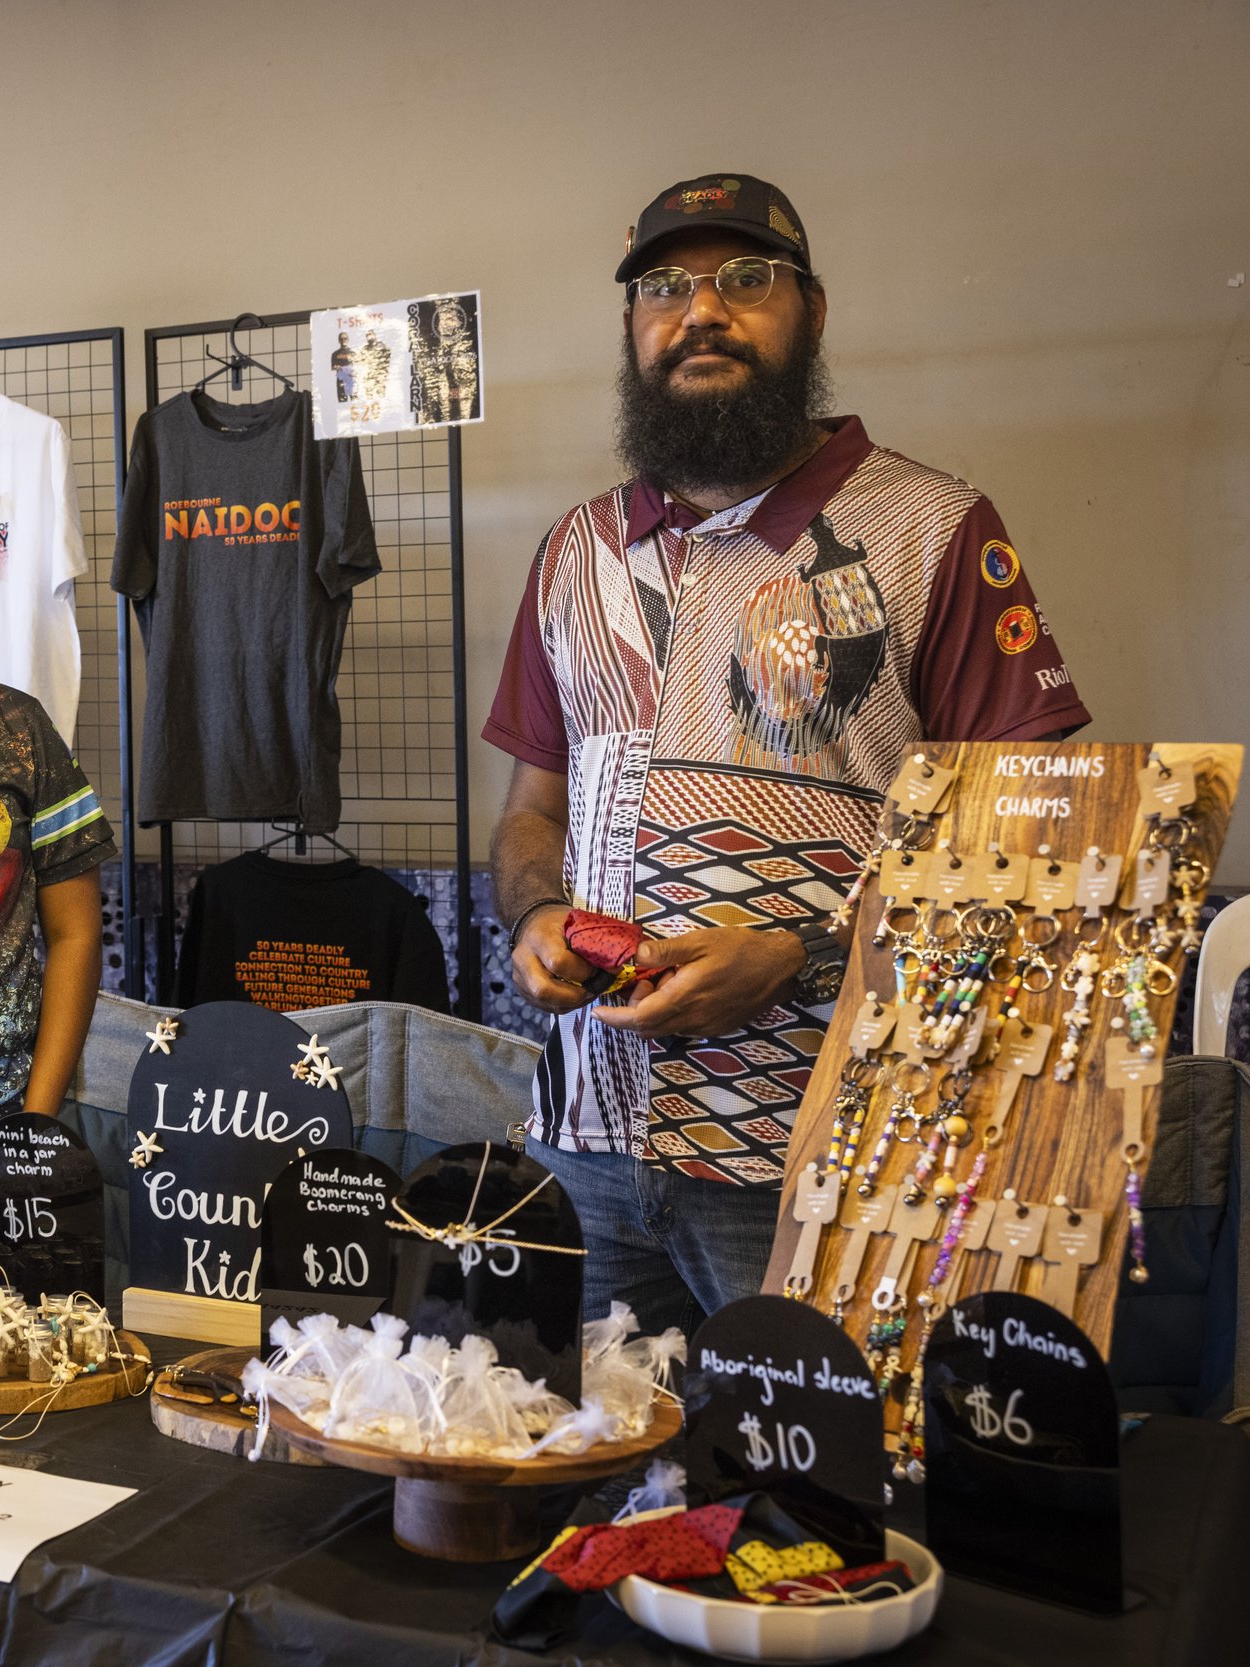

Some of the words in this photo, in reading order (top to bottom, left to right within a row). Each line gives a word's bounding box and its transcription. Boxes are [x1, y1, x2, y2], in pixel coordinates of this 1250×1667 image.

[164, 498, 221, 511] ROEBOURNE
[165, 500, 300, 540] NAIDOC
[237, 534, 268, 545] YEARS
[994, 755, 1105, 778] KEYCHAINS
[995, 796, 1071, 818] CHARMS
[249, 952, 305, 963] CELEBRATE
[307, 956, 350, 967] CULTURE
[256, 941, 270, 950] 50
[272, 942, 302, 952] YEARS
[306, 944, 344, 955] DEADLY
[278, 973, 326, 985] THROUGH
[304, 965, 317, 974] TO
[320, 967, 368, 979] COUNTRY
[245, 982, 284, 993] FUTURE
[286, 984, 356, 999] GENERATIONS
[154, 1082, 329, 1145] Little
[28, 1127, 70, 1147] beach
[3, 1142, 17, 1158] in
[19, 1149, 29, 1159] a
[33, 1149, 56, 1164] jar
[6, 1161, 53, 1176] charm
[303, 1161, 386, 1188] Handmade
[142, 1170, 273, 1229] Coun
[300, 1181, 386, 1210] Boomerang
[3, 1197, 57, 1243] $15
[303, 1242, 369, 1288] $20
[952, 1309, 997, 1358] Key
[1002, 1317, 1087, 1368] Chains
[701, 1348, 804, 1406] Aboriginal
[813, 1357, 876, 1399] sleeve
[964, 1384, 1034, 1445] $6
[738, 1411, 816, 1471] $10
